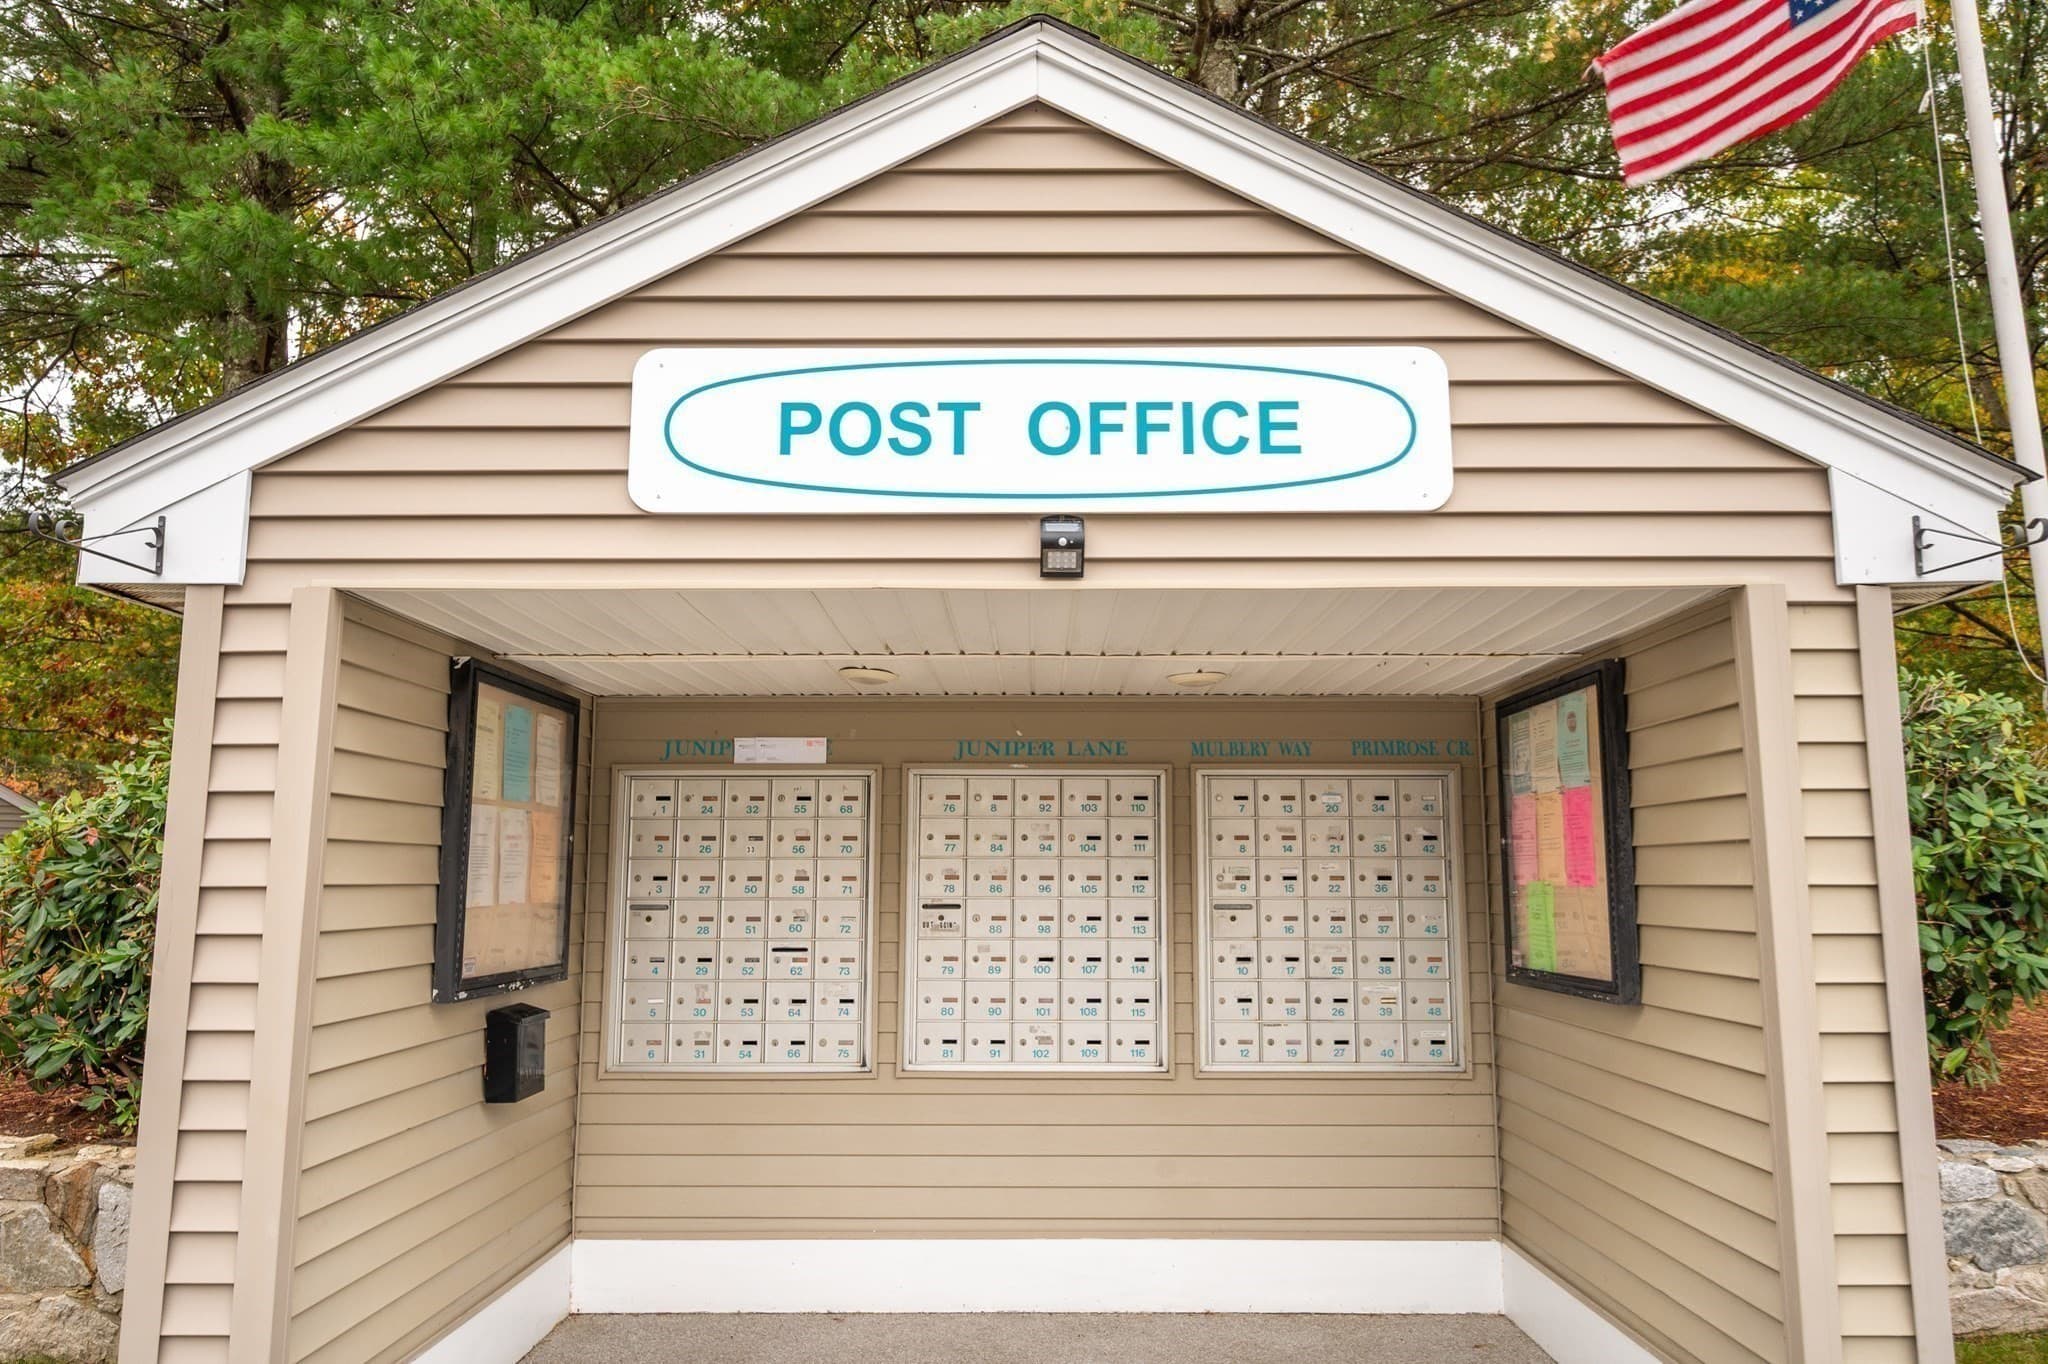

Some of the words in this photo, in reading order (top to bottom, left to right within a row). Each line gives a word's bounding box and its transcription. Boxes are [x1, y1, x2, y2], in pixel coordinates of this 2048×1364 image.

[779, 401, 981, 457] POST
[1027, 400, 1303, 456] OFFICE
[660, 739, 734, 761] JUNIP
[954, 739, 1055, 760] JUNIPER
[1068, 740, 1128, 756] LANE
[1191, 741, 1271, 757] MULBERY
[1279, 741, 1312, 757] WAY
[1351, 740, 1439, 757] PRIMROSE
[662, 803, 666, 812] 1
[701, 805, 714, 814] 24
[746, 805, 759, 814] 32
[793, 804, 807, 813] 55
[839, 805, 853, 814] 68
[943, 803, 956, 812] 76
[990, 803, 996, 812] 8
[1039, 804, 1052, 813] 92
[1079, 803, 1099, 812] 103
[1130, 803, 1145, 812] 110
[1239, 804, 1245, 813] 7
[1282, 804, 1294, 813] 13
[1325, 803, 1340, 812] 20
[1373, 803, 1385, 812] 34
[1423, 803, 1434, 812] 41
[657, 844, 664, 853] 2
[699, 845, 713, 854] 26
[792, 845, 805, 854] 56
[840, 844, 854, 853] 70
[943, 842, 957, 851] 77
[990, 844, 1005, 853] 84
[1039, 843, 1054, 852] 94
[1080, 843, 1097, 852] 104
[1133, 842, 1147, 851] 111
[1238, 844, 1246, 853] 8
[1281, 844, 1294, 853] 14
[1329, 844, 1342, 853] 21
[1374, 843, 1387, 852] 35
[1423, 845, 1436, 854] 42
[657, 885, 663, 894] 3
[698, 885, 711, 894] 27
[743, 885, 756, 894] 50
[791, 885, 805, 894] 58
[842, 885, 853, 894] 71
[944, 884, 956, 893] 78
[989, 884, 1004, 893] 86
[1037, 884, 1052, 893] 96
[1080, 884, 1099, 893] 105
[1131, 884, 1145, 893] 112
[1239, 884, 1246, 893] 9
[1283, 884, 1294, 893] 15
[1329, 884, 1340, 893] 22
[1375, 884, 1389, 893] 36
[1423, 884, 1437, 893] 43
[696, 926, 710, 935] 28
[744, 925, 757, 934] 51
[787, 924, 803, 933] 60
[839, 924, 852, 933] 72
[1037, 924, 1052, 933] 98
[1079, 925, 1097, 934] 106
[1132, 925, 1147, 934] 113
[1282, 925, 1294, 934] 16
[1329, 925, 1343, 934] 23
[1377, 925, 1390, 934] 37
[1424, 926, 1439, 935] 45
[652, 967, 659, 976] 4
[695, 966, 709, 975] 29
[741, 966, 755, 975] 52
[789, 966, 803, 975] 62
[838, 967, 851, 976] 73
[941, 965, 955, 974] 79
[987, 966, 1002, 975] 89
[1032, 965, 1051, 974] 100
[1081, 965, 1098, 974] 107
[1130, 965, 1146, 974] 114
[1236, 966, 1248, 975] 10
[1285, 966, 1296, 975] 17
[1331, 966, 1344, 975] 25
[1379, 965, 1392, 974] 38
[1426, 966, 1438, 975] 47
[648, 1008, 656, 1017] 5
[694, 1008, 706, 1017] 30
[740, 1008, 754, 1017] 53
[788, 1009, 801, 1018] 64
[837, 1007, 850, 1016] 74
[941, 1008, 954, 1017] 80
[988, 1008, 1002, 1017] 90
[1034, 1007, 1050, 1016] 101
[1080, 1008, 1097, 1017] 108
[1130, 1008, 1145, 1017] 115
[1240, 1008, 1249, 1017] 11
[1285, 1007, 1296, 1016] 18
[1332, 1008, 1344, 1017] 26
[1378, 1007, 1392, 1016] 39
[1427, 1007, 1442, 1016] 48
[647, 1050, 655, 1059] 6
[694, 1050, 705, 1059] 31
[738, 1050, 752, 1059] 54
[785, 1049, 800, 1058] 66
[837, 1048, 849, 1057] 75
[942, 1048, 954, 1057] 81
[990, 1048, 1001, 1057] 91
[1032, 1049, 1049, 1058] 102
[1081, 1048, 1099, 1057] 109
[1129, 1048, 1145, 1057] 116
[1239, 1048, 1248, 1057] 12
[1286, 1048, 1298, 1057] 19
[1334, 1048, 1345, 1057] 27
[1379, 1048, 1394, 1057] 40
[1429, 1048, 1442, 1057] 49
